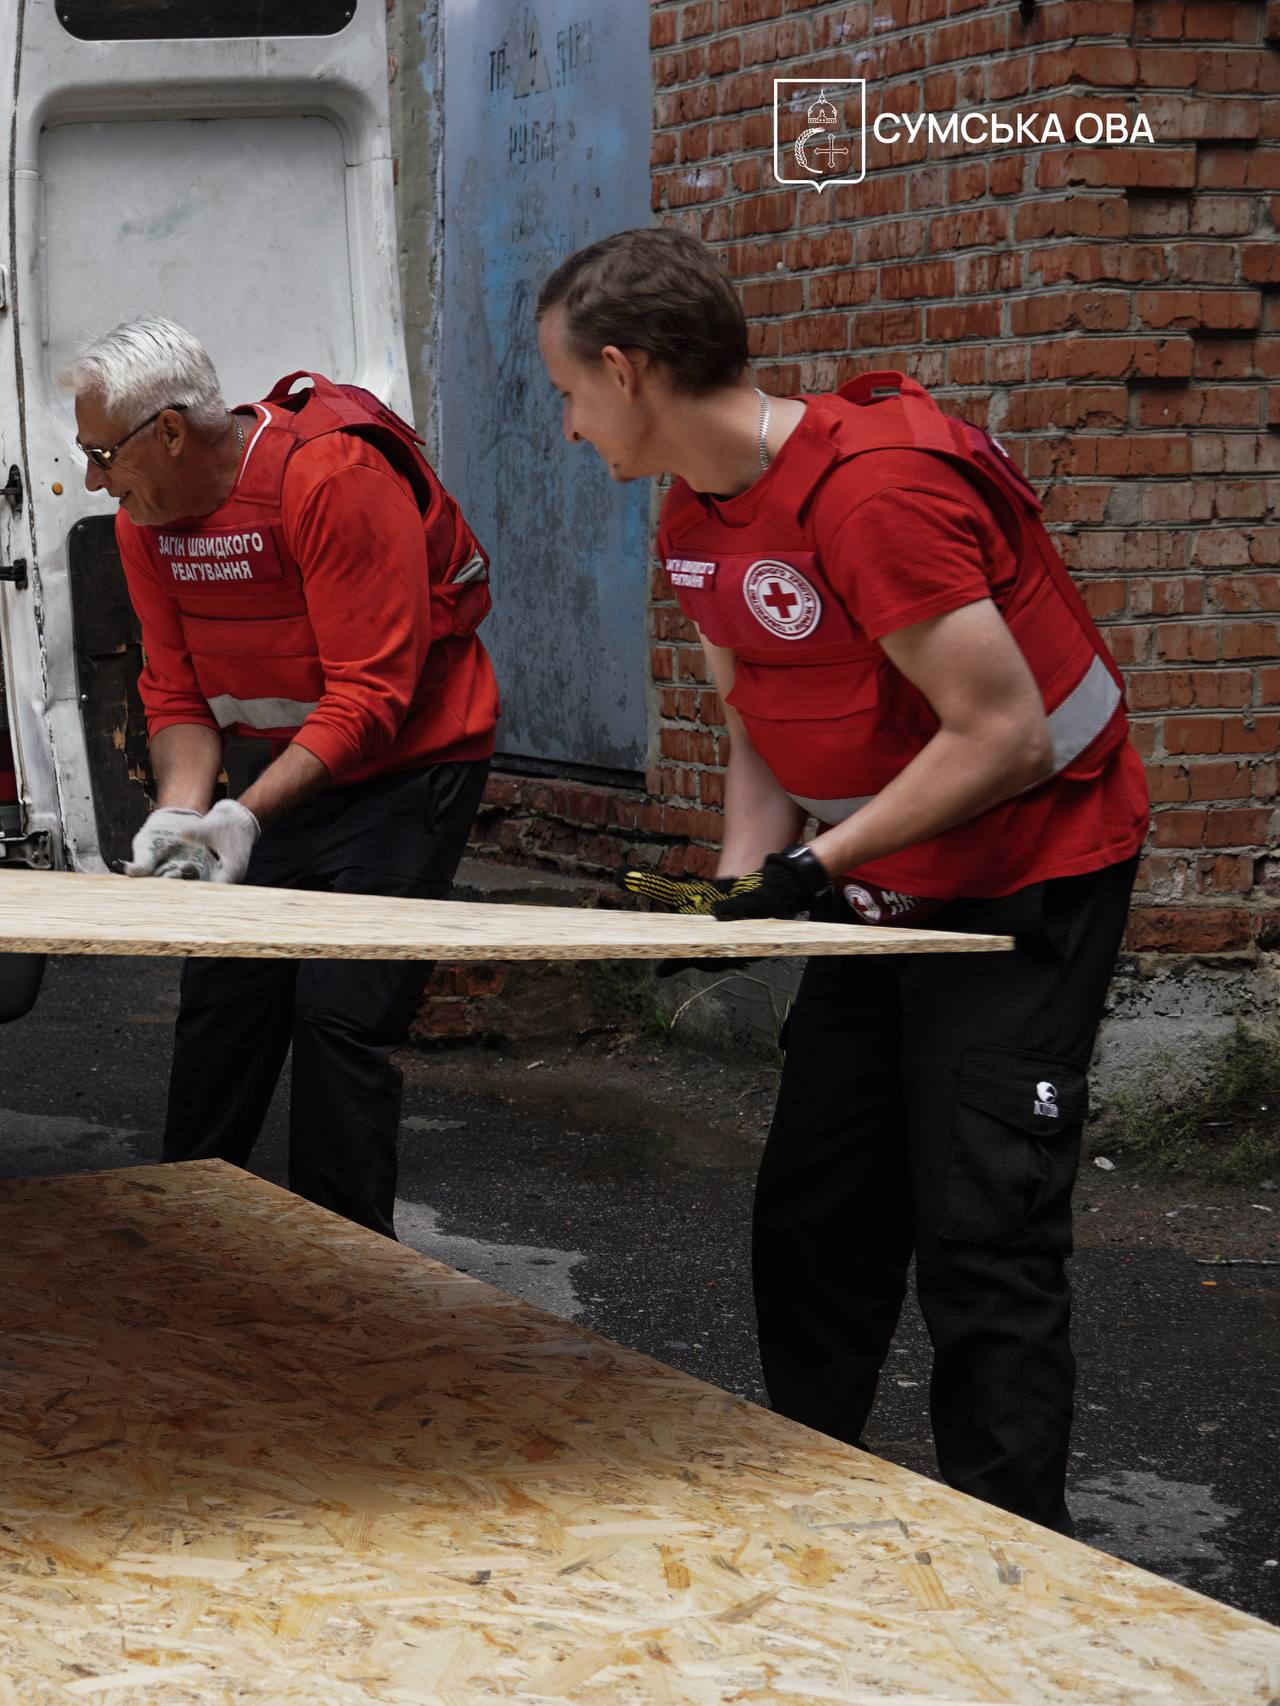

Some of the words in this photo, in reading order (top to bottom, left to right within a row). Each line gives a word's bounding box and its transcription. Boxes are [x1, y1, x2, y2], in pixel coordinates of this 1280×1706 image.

[158, 535, 185, 556] ЗАГІН
[187, 532, 263, 559] ШВИДКОГО
[170, 560, 254, 581] РЕАГУВАННЯ
